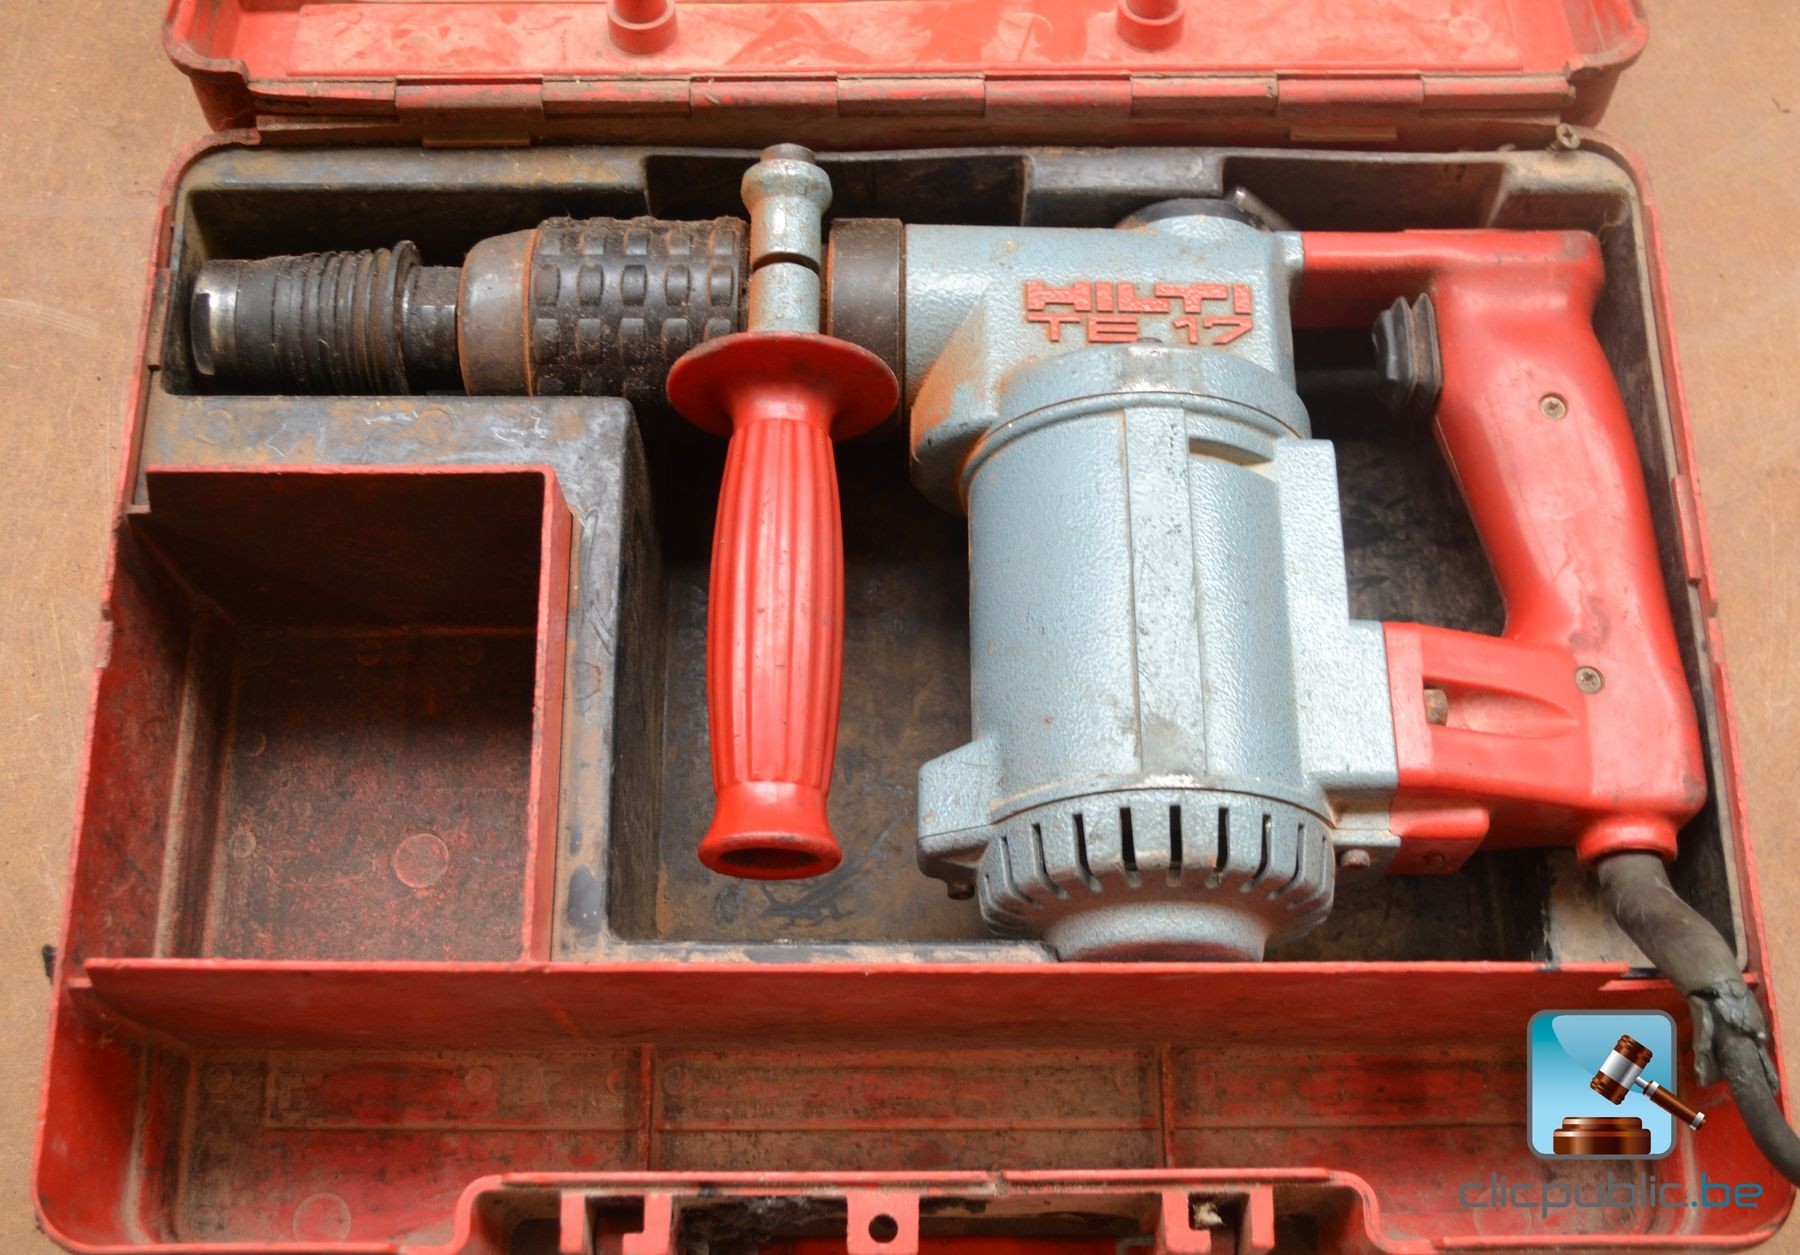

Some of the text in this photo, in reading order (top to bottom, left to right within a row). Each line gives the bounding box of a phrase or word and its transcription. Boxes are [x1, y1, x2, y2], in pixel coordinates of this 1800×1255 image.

[1026, 281, 1252, 314] HILTI
[1027, 313, 1254, 345] TE 17
